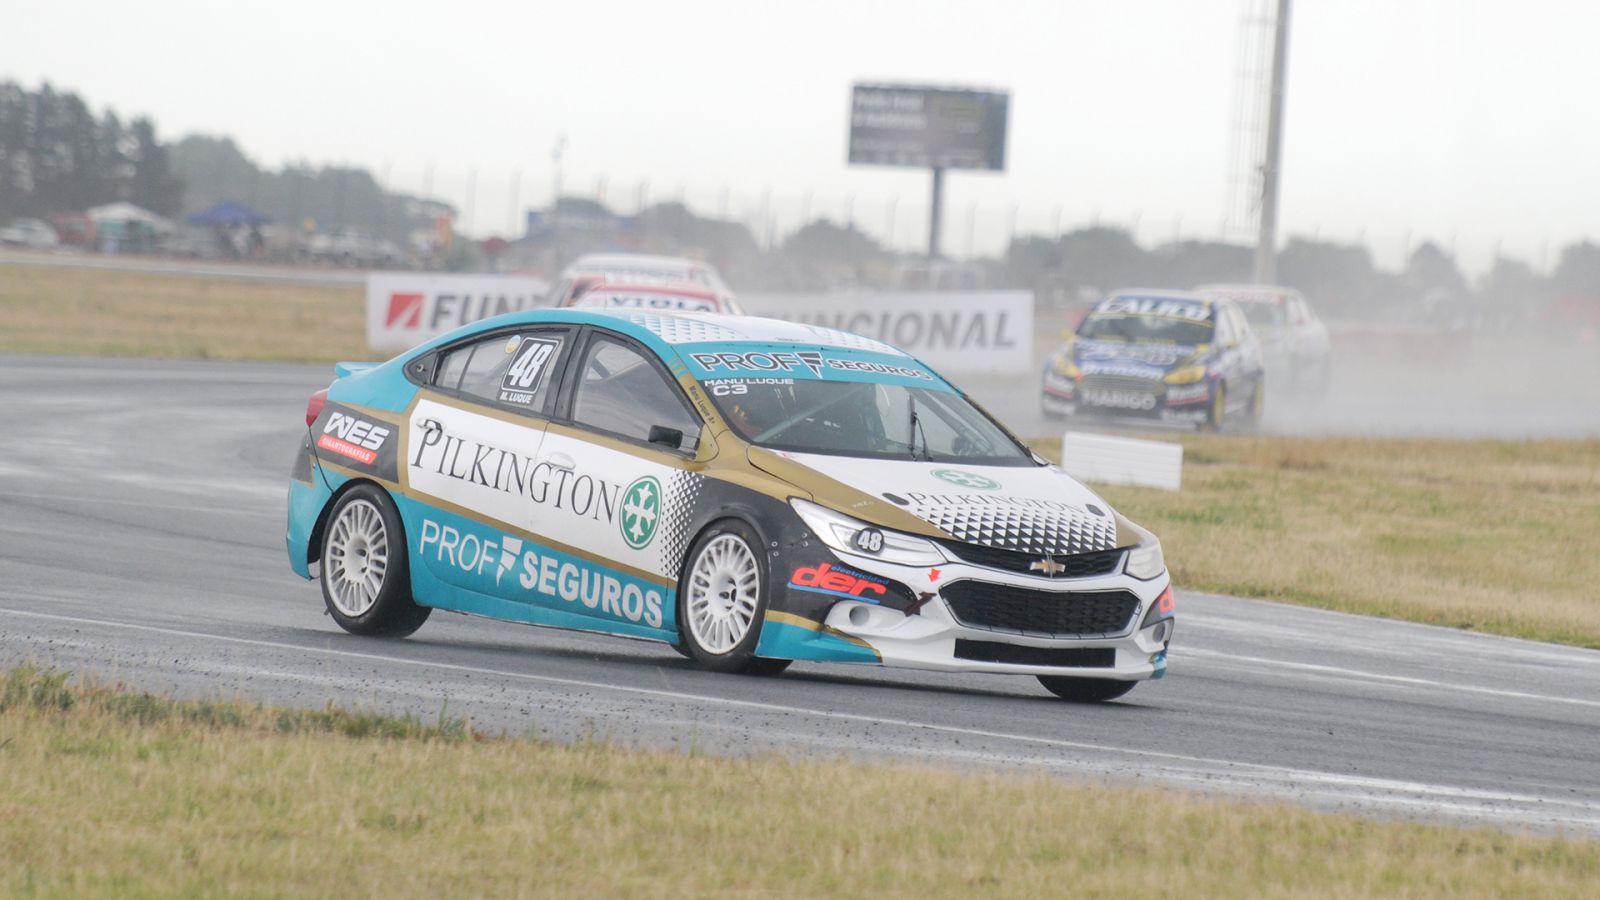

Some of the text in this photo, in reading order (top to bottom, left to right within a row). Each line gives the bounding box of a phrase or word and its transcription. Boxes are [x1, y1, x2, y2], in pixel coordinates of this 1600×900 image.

[508, 343, 554, 388] 48
[826, 358, 934, 381] SEGUROS
[704, 378, 747, 388] MANU
[712, 384, 748, 396] C3
[509, 392, 533, 404] LUQUE
[323, 412, 390, 451] WES
[410, 418, 622, 524] PILKINGTON
[906, 491, 1084, 514] PILKINGTON
[857, 530, 883, 552] 48
[791, 562, 887, 596] der
[831, 564, 890, 585] electricidad
[519, 550, 663, 628] SEGUROS
